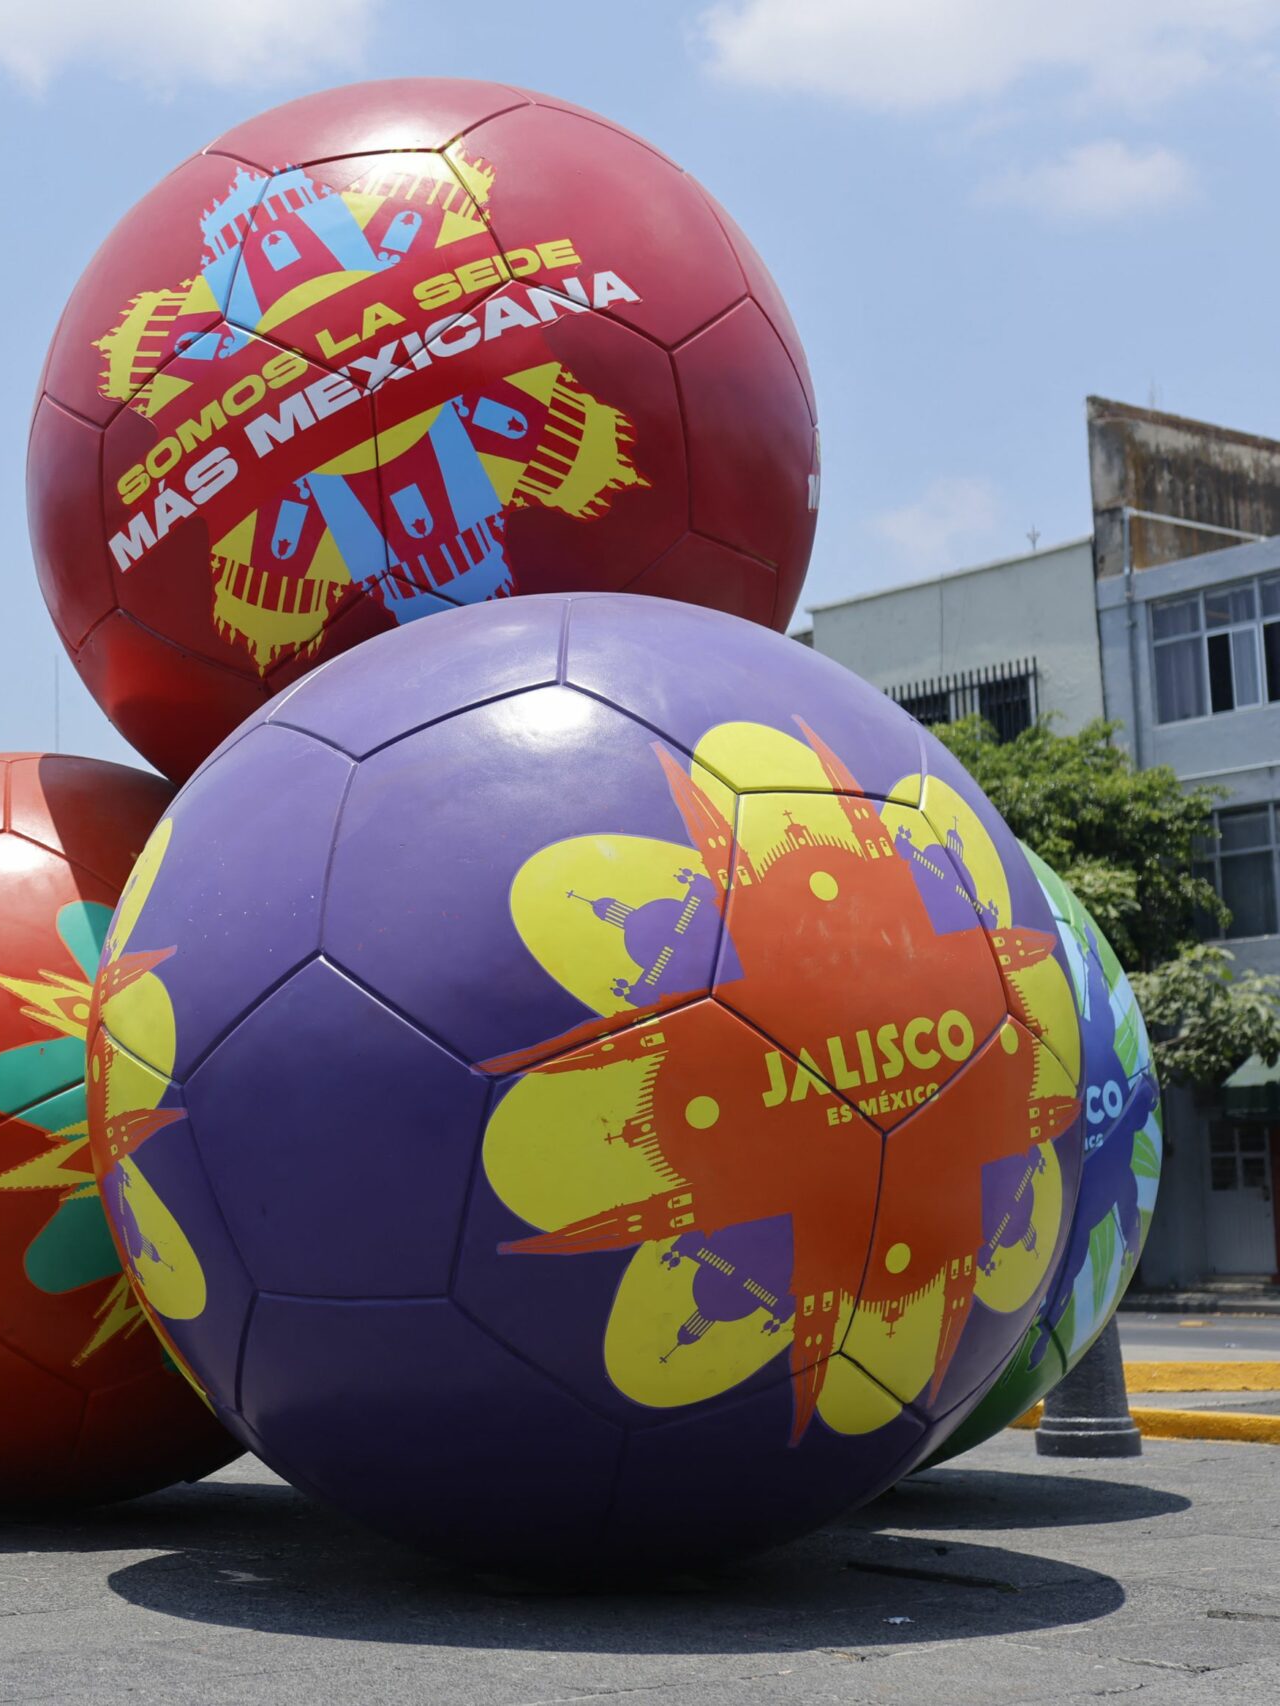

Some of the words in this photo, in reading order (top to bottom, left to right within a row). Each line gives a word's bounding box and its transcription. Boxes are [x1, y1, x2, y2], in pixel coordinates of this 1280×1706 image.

[108, 446, 239, 573] MÁS
[243, 270, 642, 459] MEXICANA
[117, 348, 309, 505] SOMOS
[315, 302, 407, 360] LA
[412, 238, 582, 311] SEDE
[762, 1009, 975, 1108] JALISCO
[826, 1104, 853, 1126] ES
[858, 1082, 941, 1118] MÉXICO
